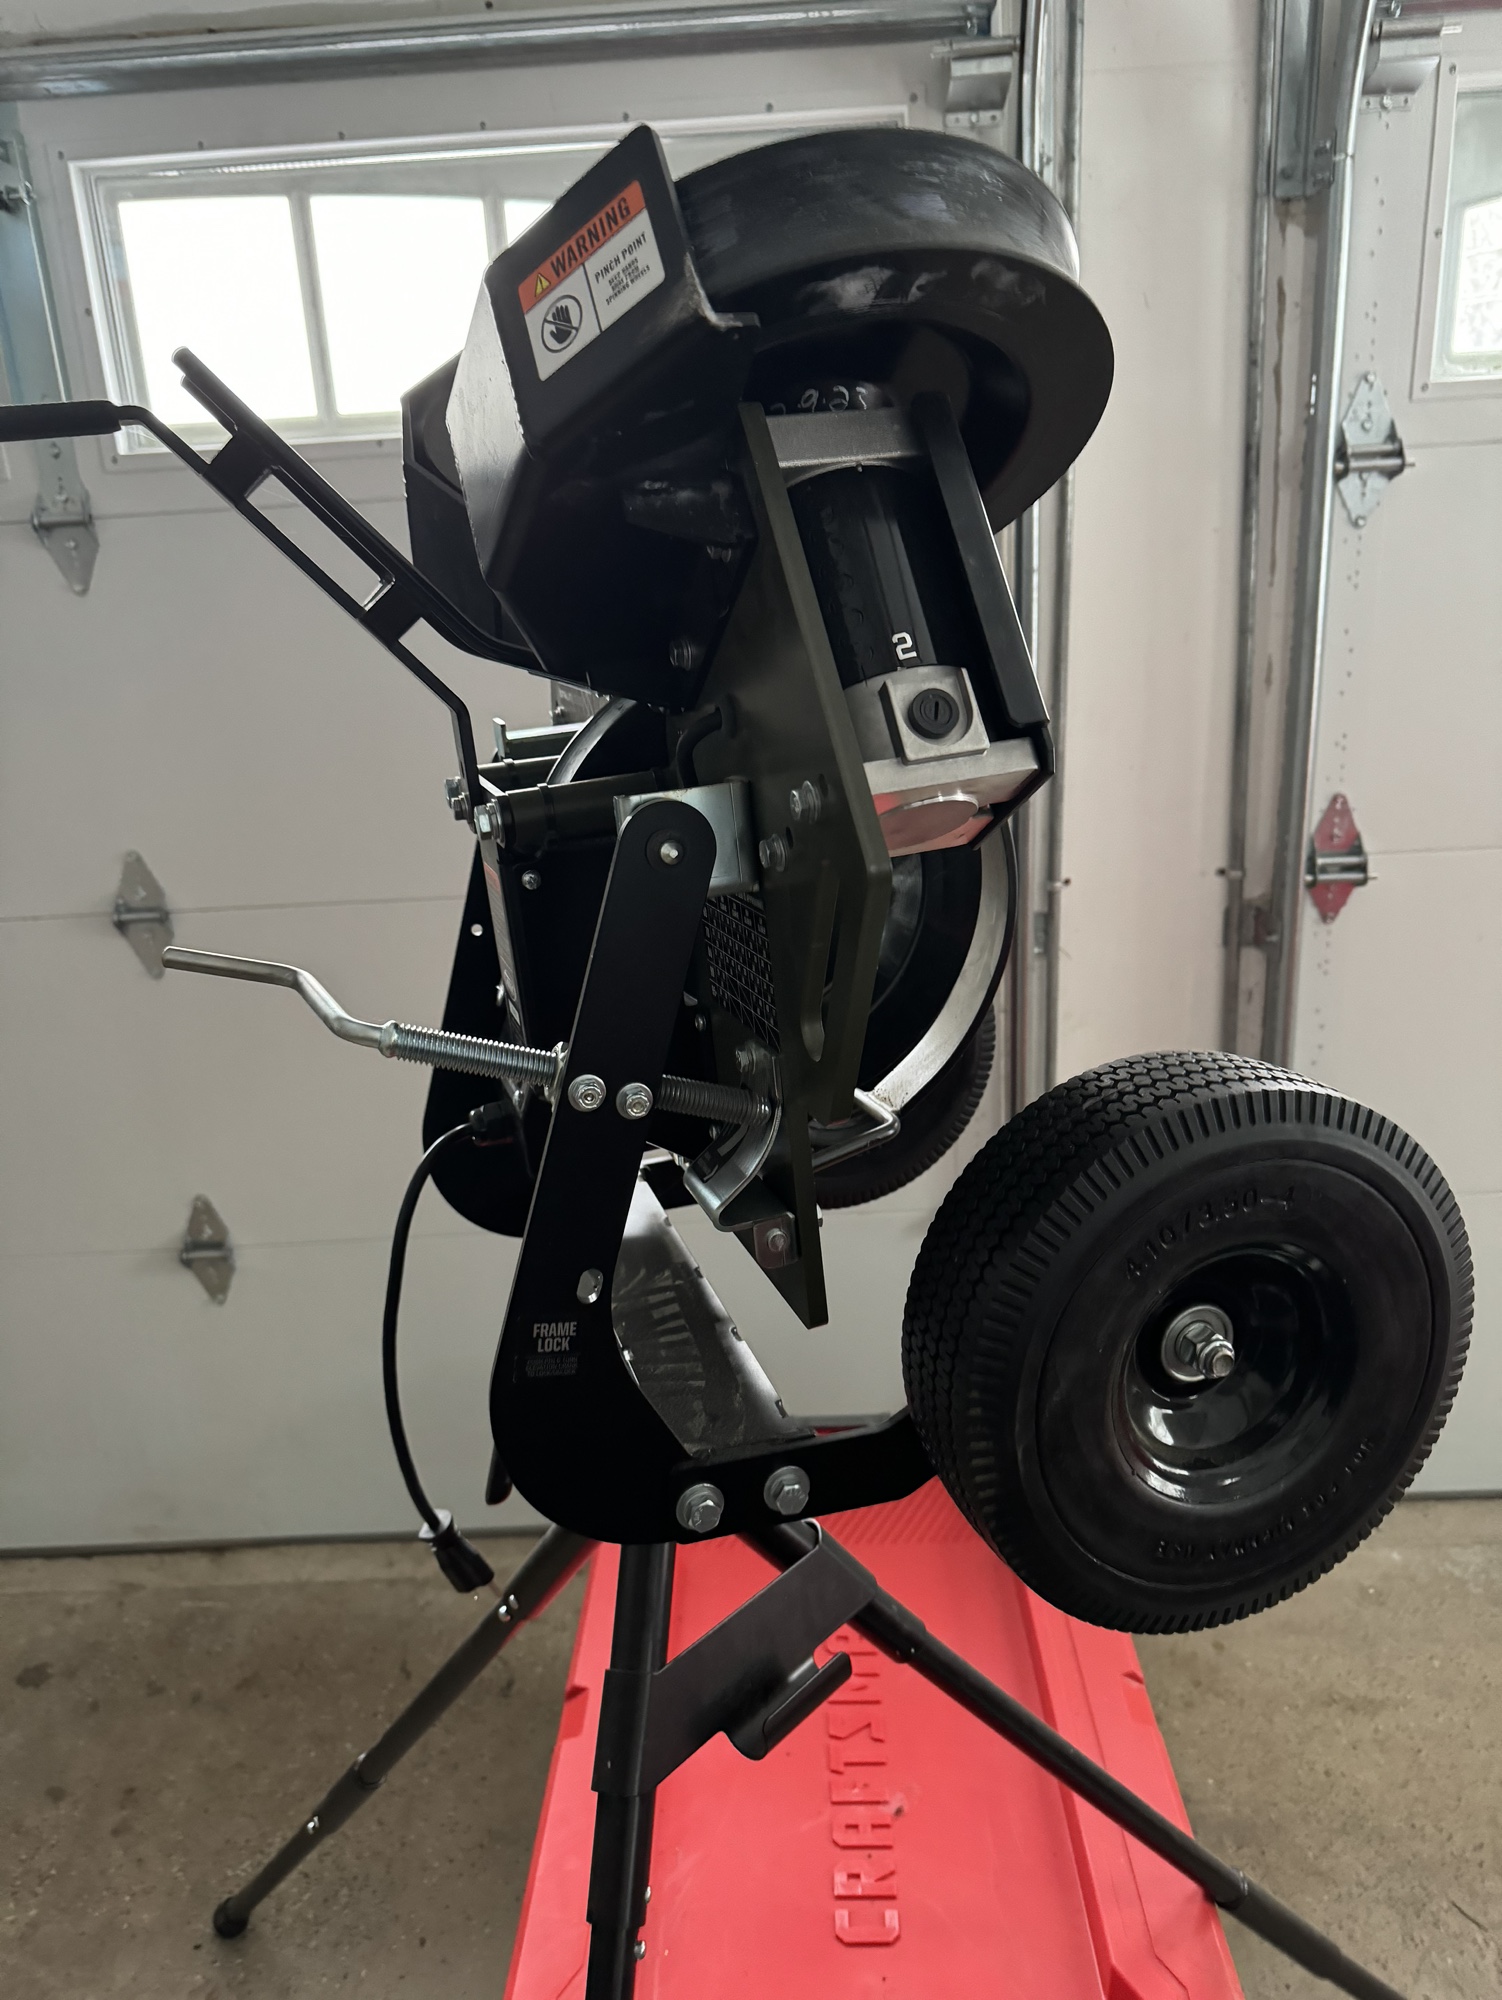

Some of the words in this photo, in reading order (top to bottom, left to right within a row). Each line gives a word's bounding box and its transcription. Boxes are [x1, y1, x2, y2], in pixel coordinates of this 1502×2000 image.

[550, 197, 631, 279] WARNING
[595, 254, 620, 284] PINCH
[621, 231, 647, 260] POINT
[891, 631, 918, 661] 2
[533, 1321, 578, 1338] FRAME
[537, 1337, 570, 1353] LOCK
[826, 1624, 901, 1947] CRAFTSMA
